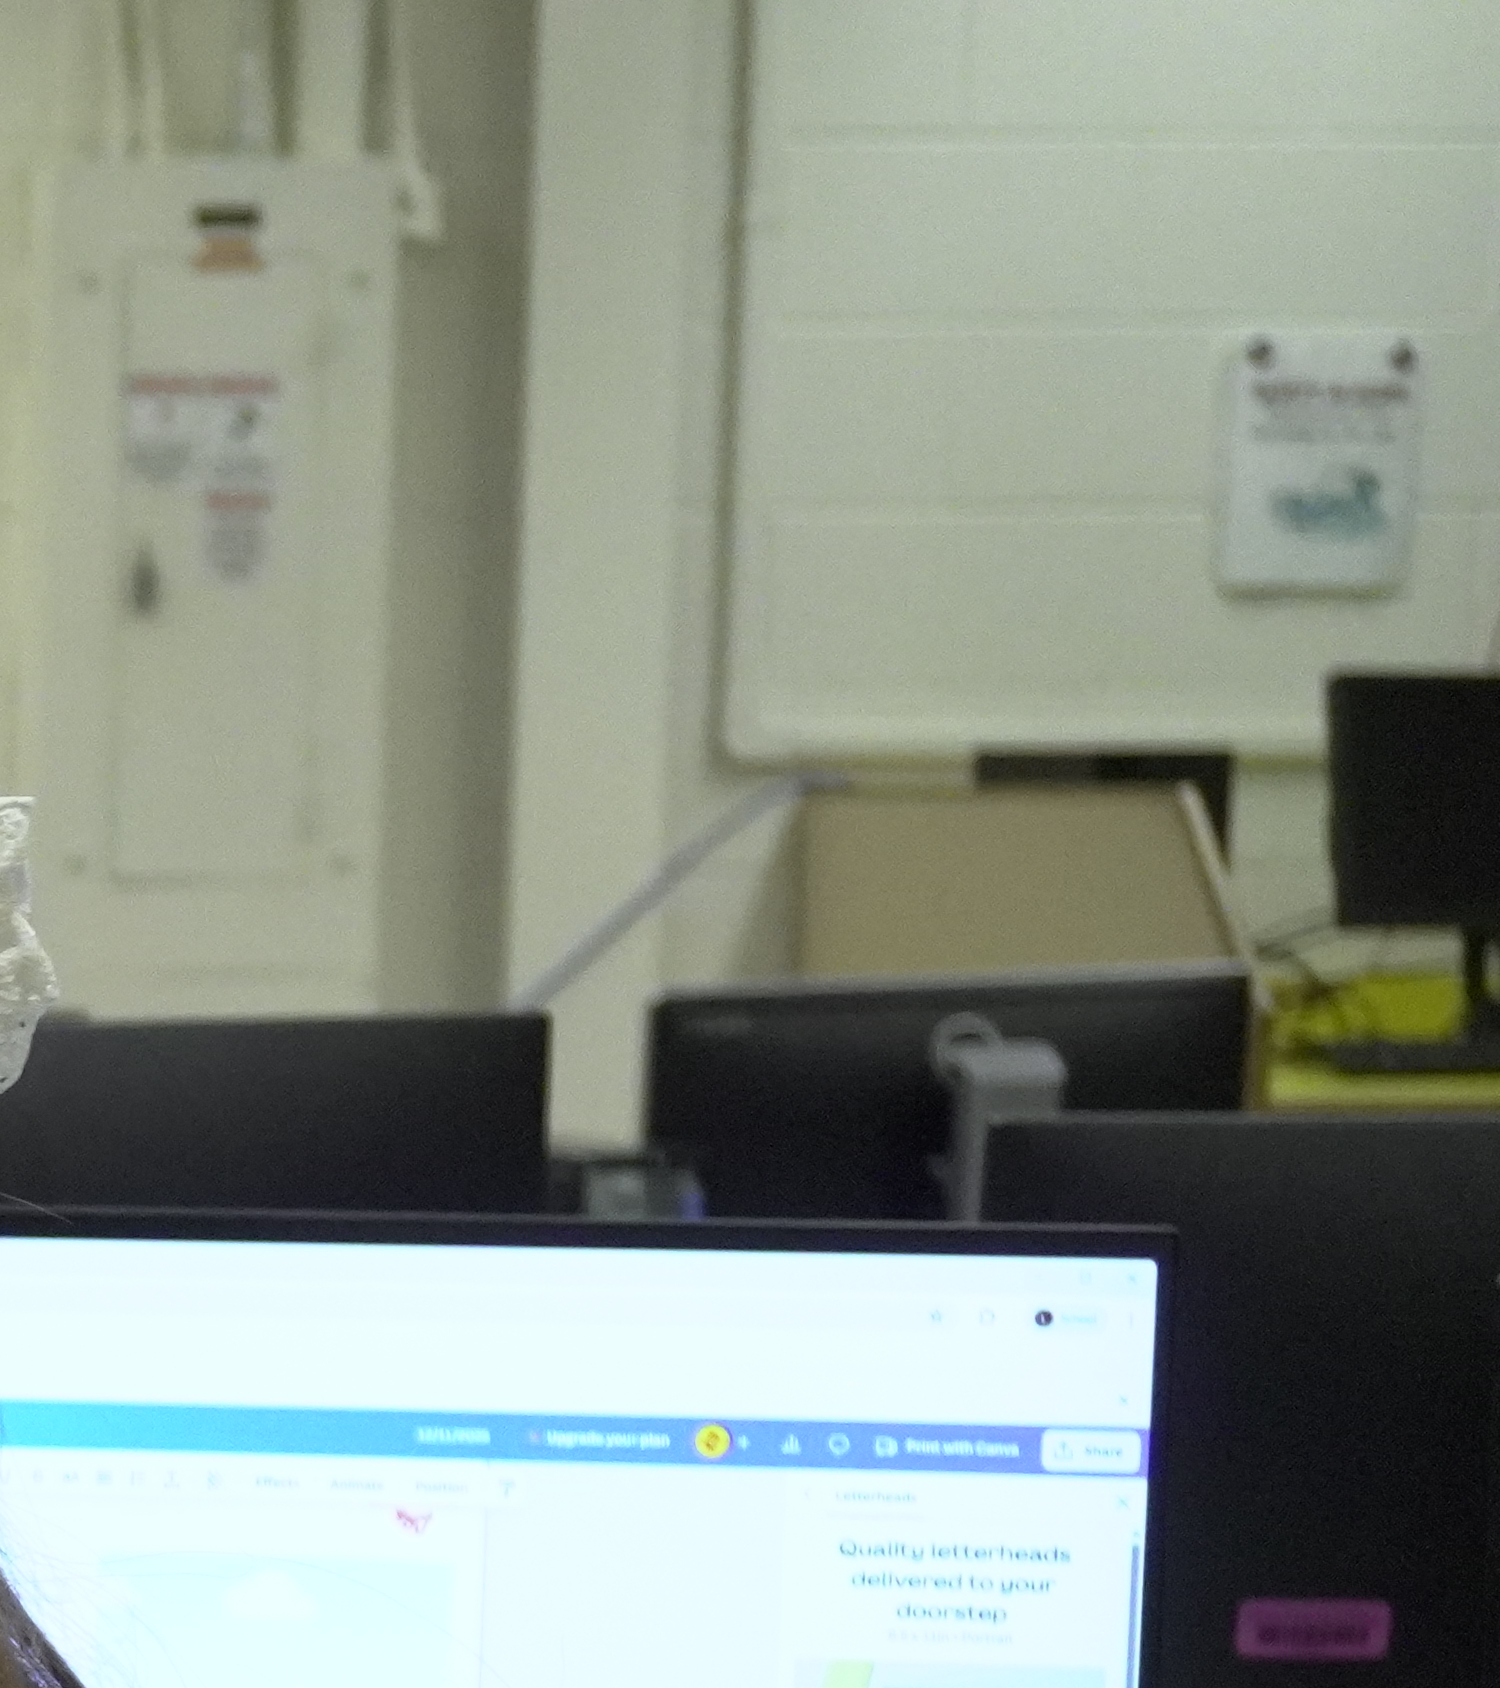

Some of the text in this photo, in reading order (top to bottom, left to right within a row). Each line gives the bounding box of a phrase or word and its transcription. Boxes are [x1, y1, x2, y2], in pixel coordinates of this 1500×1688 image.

[546, 1429, 671, 1450] Upgrade your plan
[905, 1436, 1020, 1458] Print with Canva
[1084, 1444, 1124, 1458] Share
[254, 1476, 299, 1491] Effects
[330, 1477, 384, 1492] Animate
[415, 1480, 469, 1495] Position
[835, 1489, 917, 1504] Letterheads
[837, 1541, 1072, 1563] Quality letterheads
[849, 1571, 1056, 1595] delivered to your
[895, 1602, 1008, 1625] doorstep
